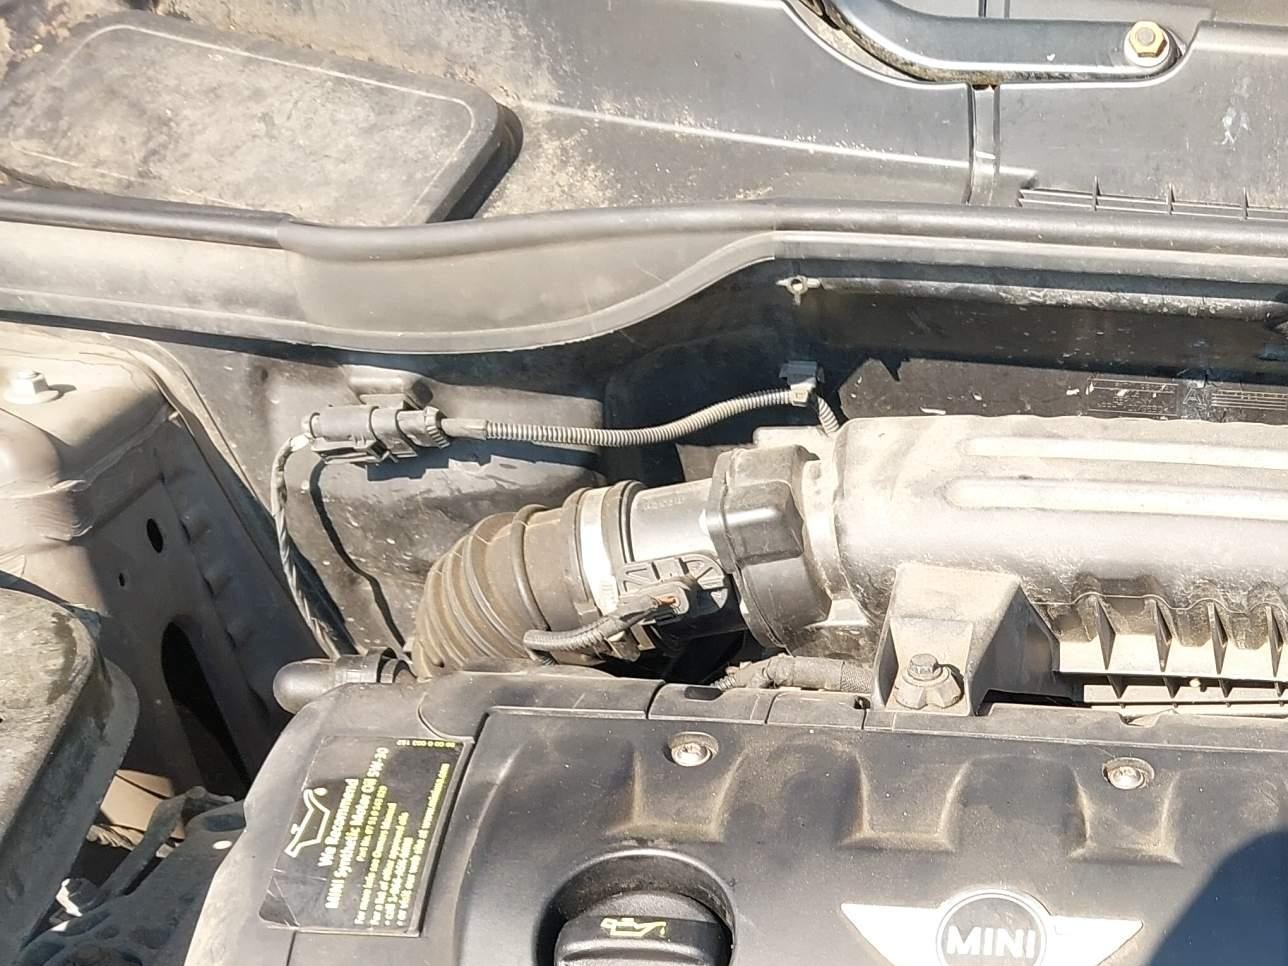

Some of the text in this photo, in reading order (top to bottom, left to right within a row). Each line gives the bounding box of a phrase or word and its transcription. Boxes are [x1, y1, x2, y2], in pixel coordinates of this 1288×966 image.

[317, 778, 358, 866] We Recommend
[380, 802, 397, 829] Manual
[397, 811, 409, 825] oils
[325, 747, 389, 909] MINI Synthetic Motor Oil 5W-30
[417, 829, 428, 839] at
[388, 825, 407, 859] approved
[413, 838, 425, 854] site
[355, 846, 368, 861] Part
[369, 858, 380, 871] see
[382, 859, 395, 881] other
[408, 854, 421, 873] web
[362, 871, 376, 888] info
[376, 880, 389, 890] of
[404, 873, 415, 889] our
[357, 888, 372, 910] more
[373, 890, 387, 904] list
[397, 889, 412, 909] visit
[353, 910, 367, 924] For
[368, 910, 382, 925] For
[381, 902, 397, 919] call
[395, 909, 407, 920] or
[945, 925, 1036, 959] MINI
